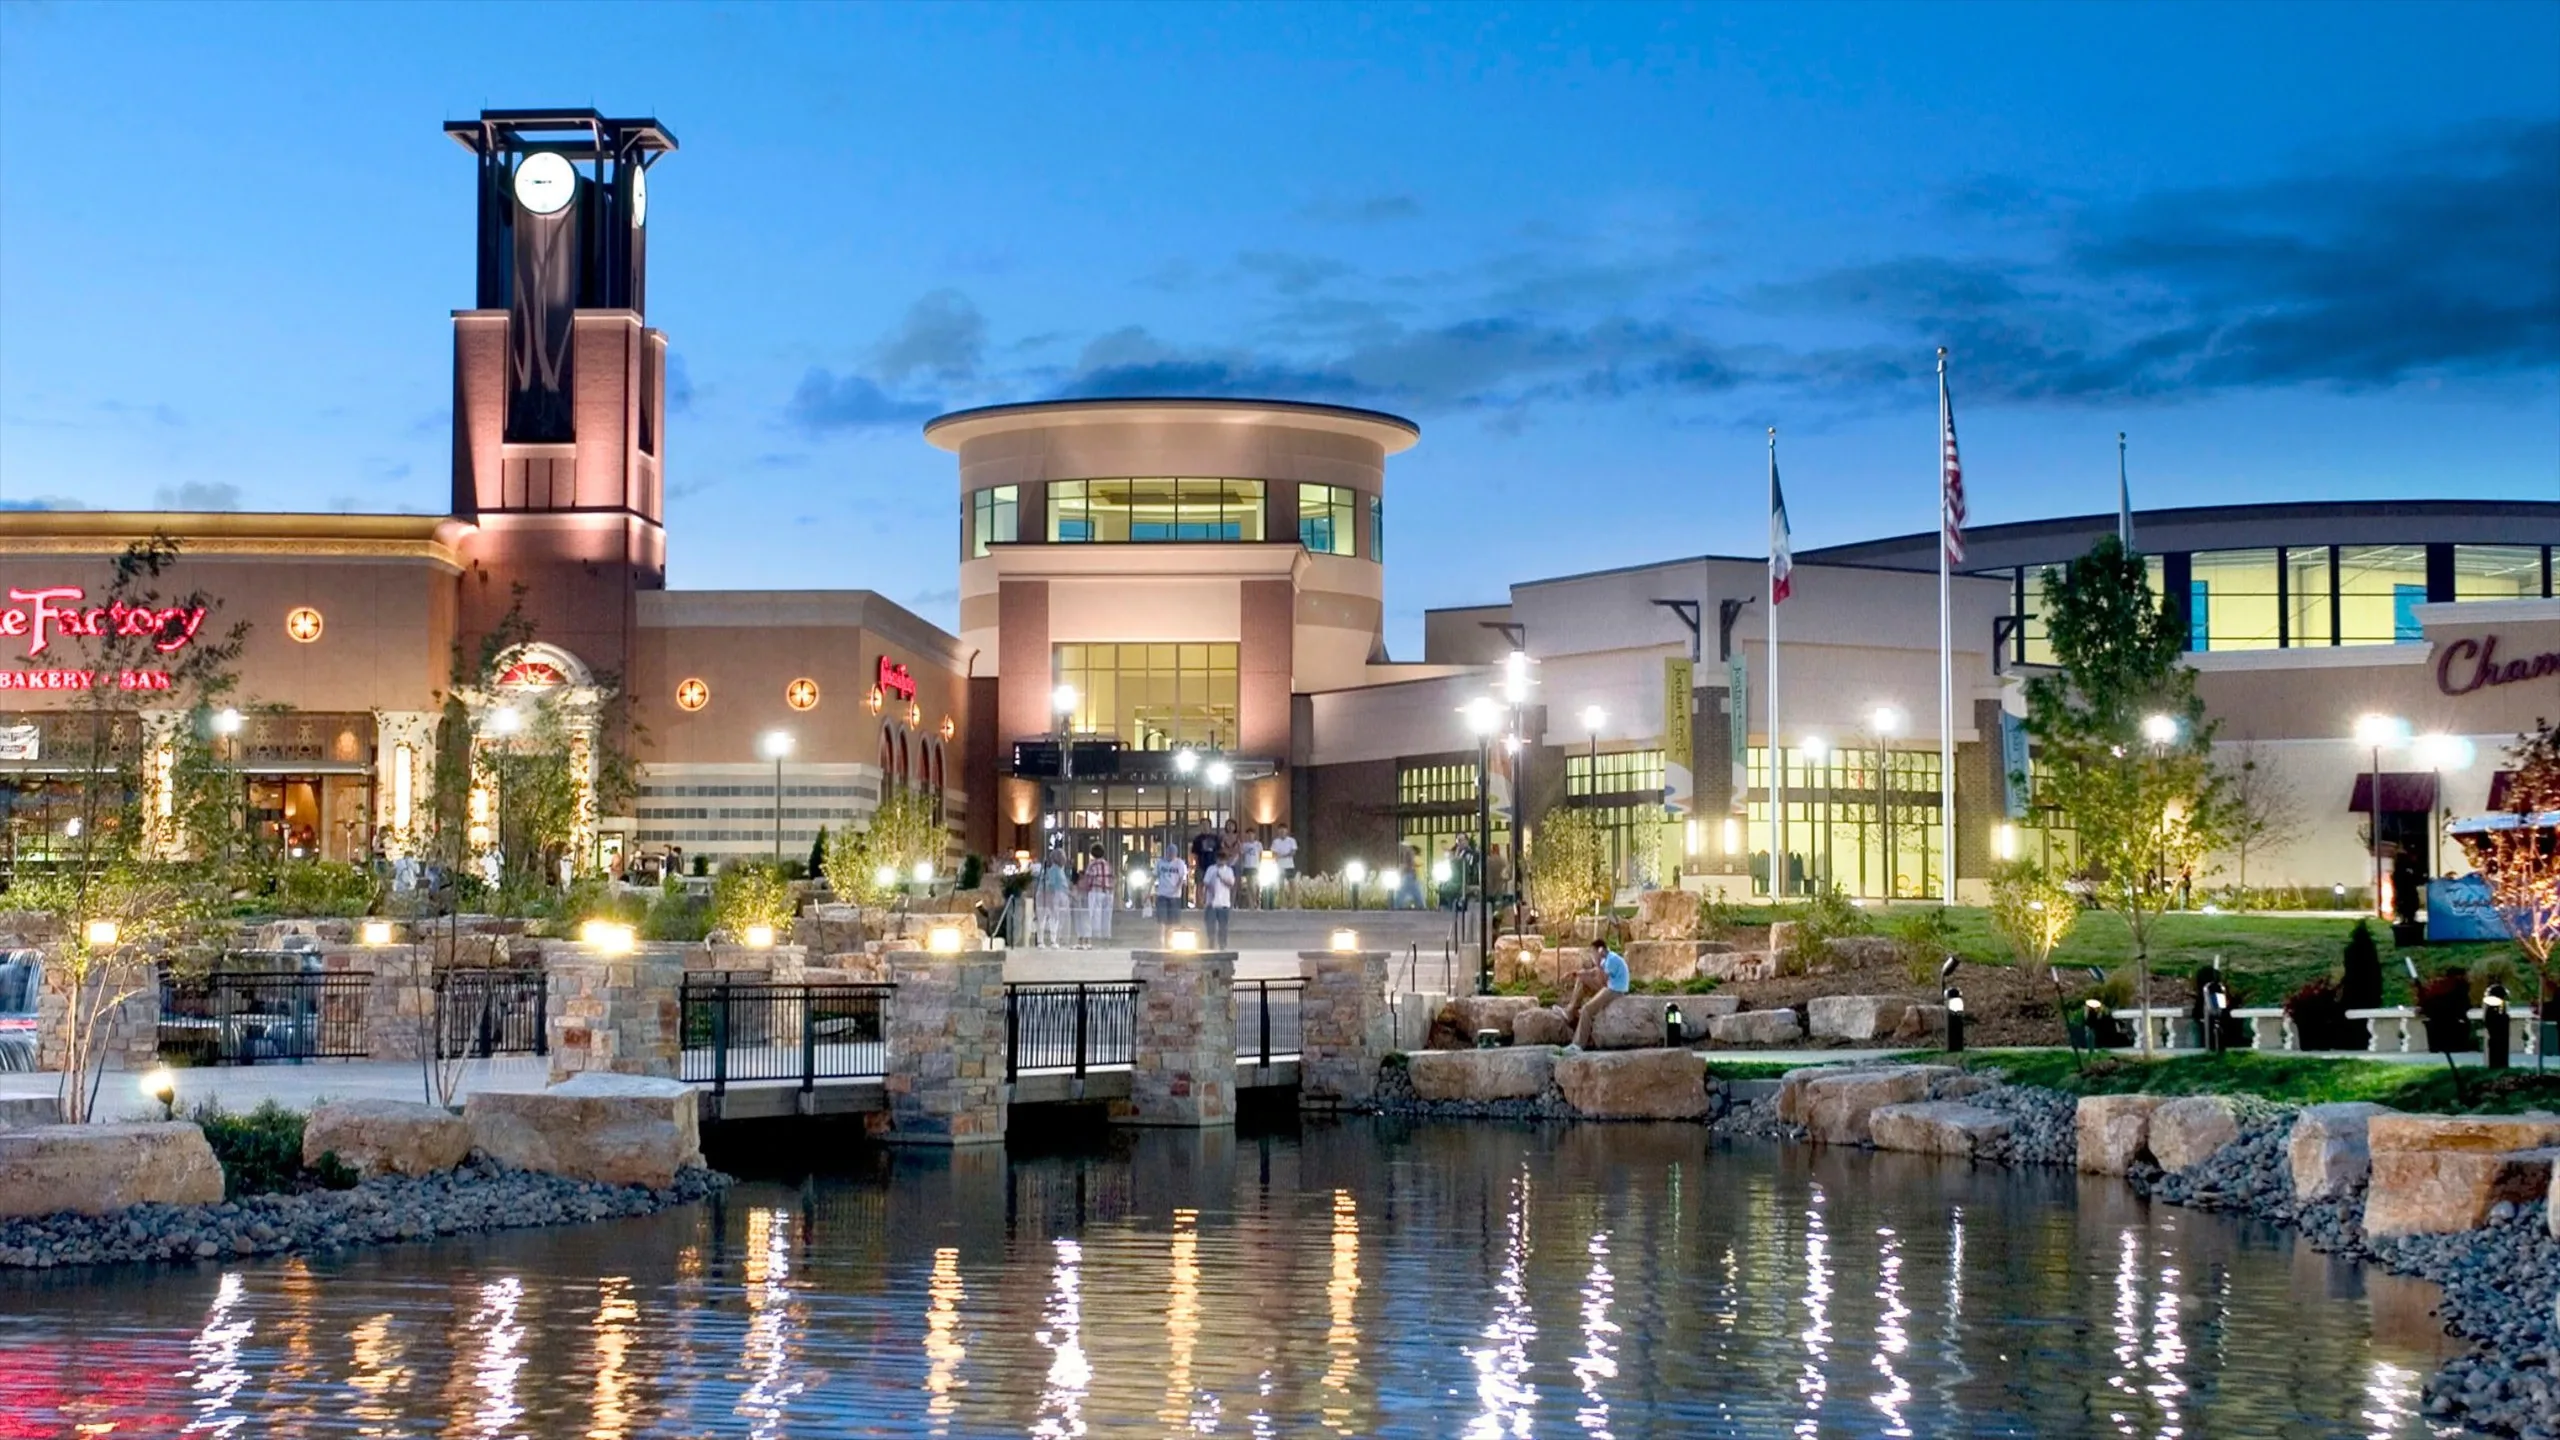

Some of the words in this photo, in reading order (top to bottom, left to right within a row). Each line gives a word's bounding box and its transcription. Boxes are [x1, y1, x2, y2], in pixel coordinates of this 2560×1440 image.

[9, 586, 207, 656] Factory
[0, 669, 95, 690] BAKERY
[119, 669, 171, 690] BAR
